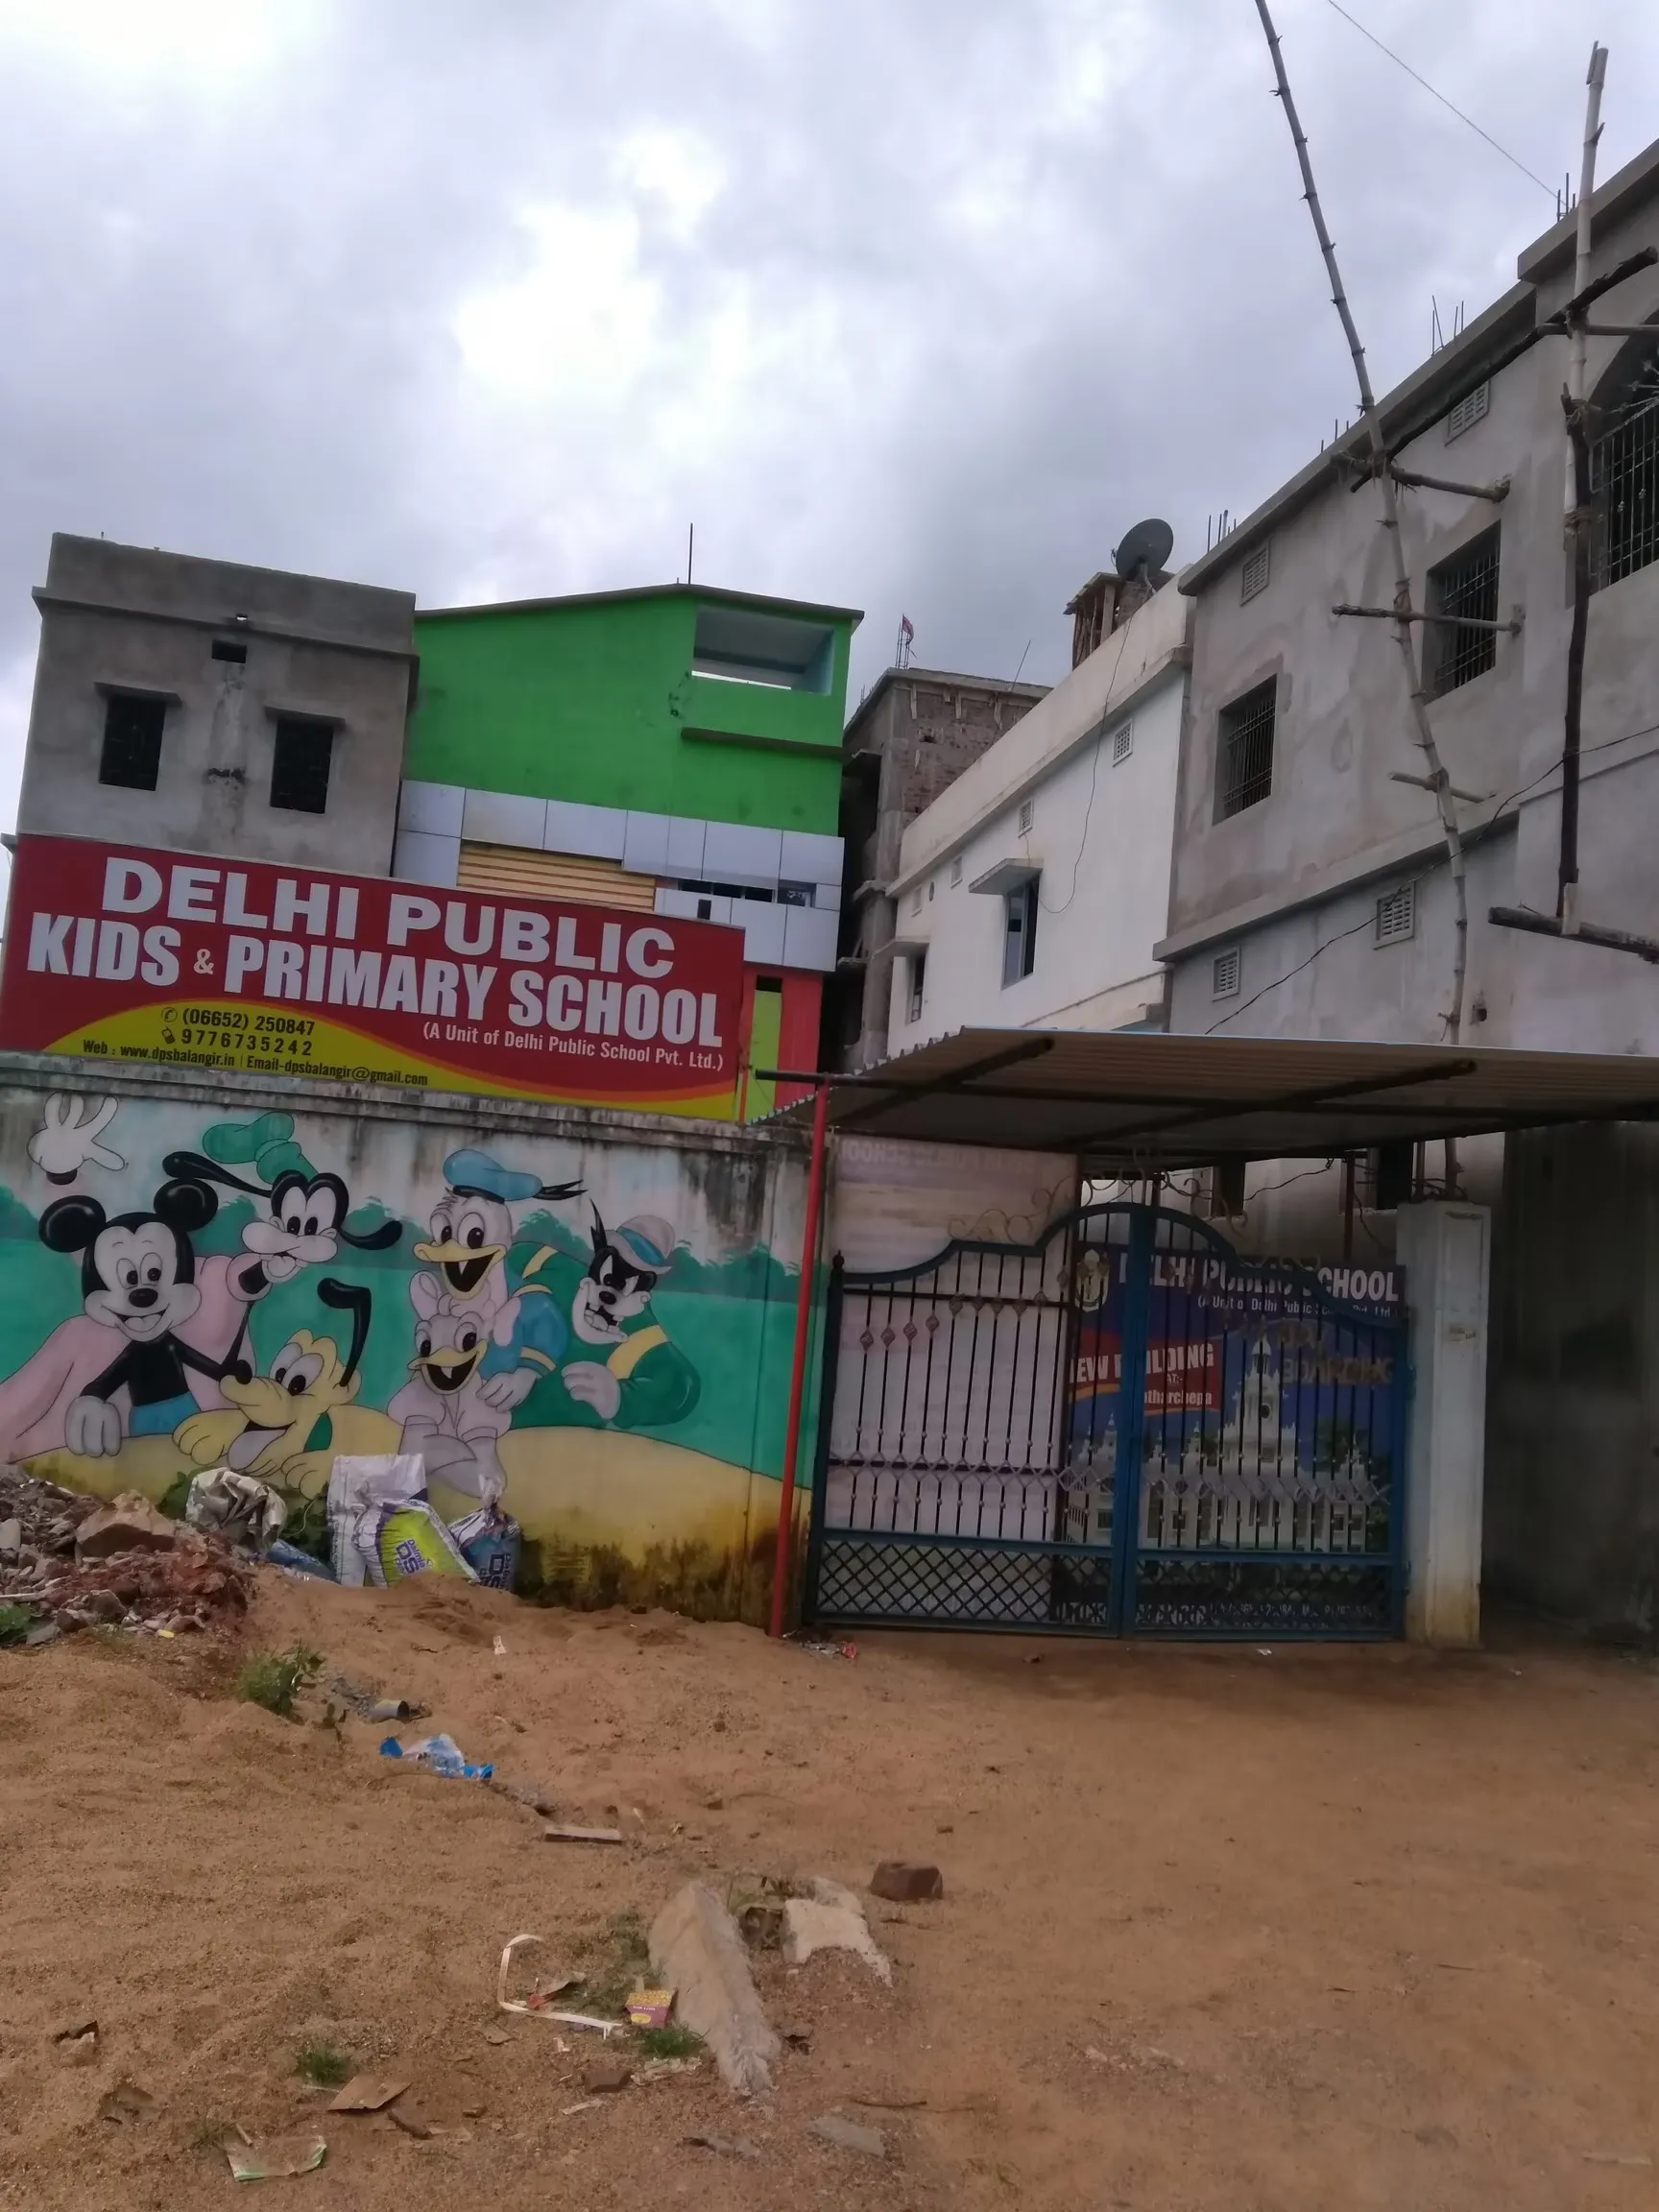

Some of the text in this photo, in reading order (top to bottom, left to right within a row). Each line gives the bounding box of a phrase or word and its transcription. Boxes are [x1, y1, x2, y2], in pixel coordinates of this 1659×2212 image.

[102, 856, 675, 979] DELHI PUBLIC
[27, 912, 722, 1047] KIDS & PRIMARY SCHOOL
[181, 1028, 312, 1056] 9776735242
[182, 1008, 315, 1036] (06652) 250847
[83, 1040, 108, 1055] Web
[120, 1046, 234, 1068] www.dpsbalangir.in
[247, 1055, 428, 1086] Email-dpsbalangir@gmail.com
[423, 1022, 723, 1071] (A Unit of Delhi Public School Pvt. Ltd.)
[1303, 1267, 1399, 1302] CHOOL
